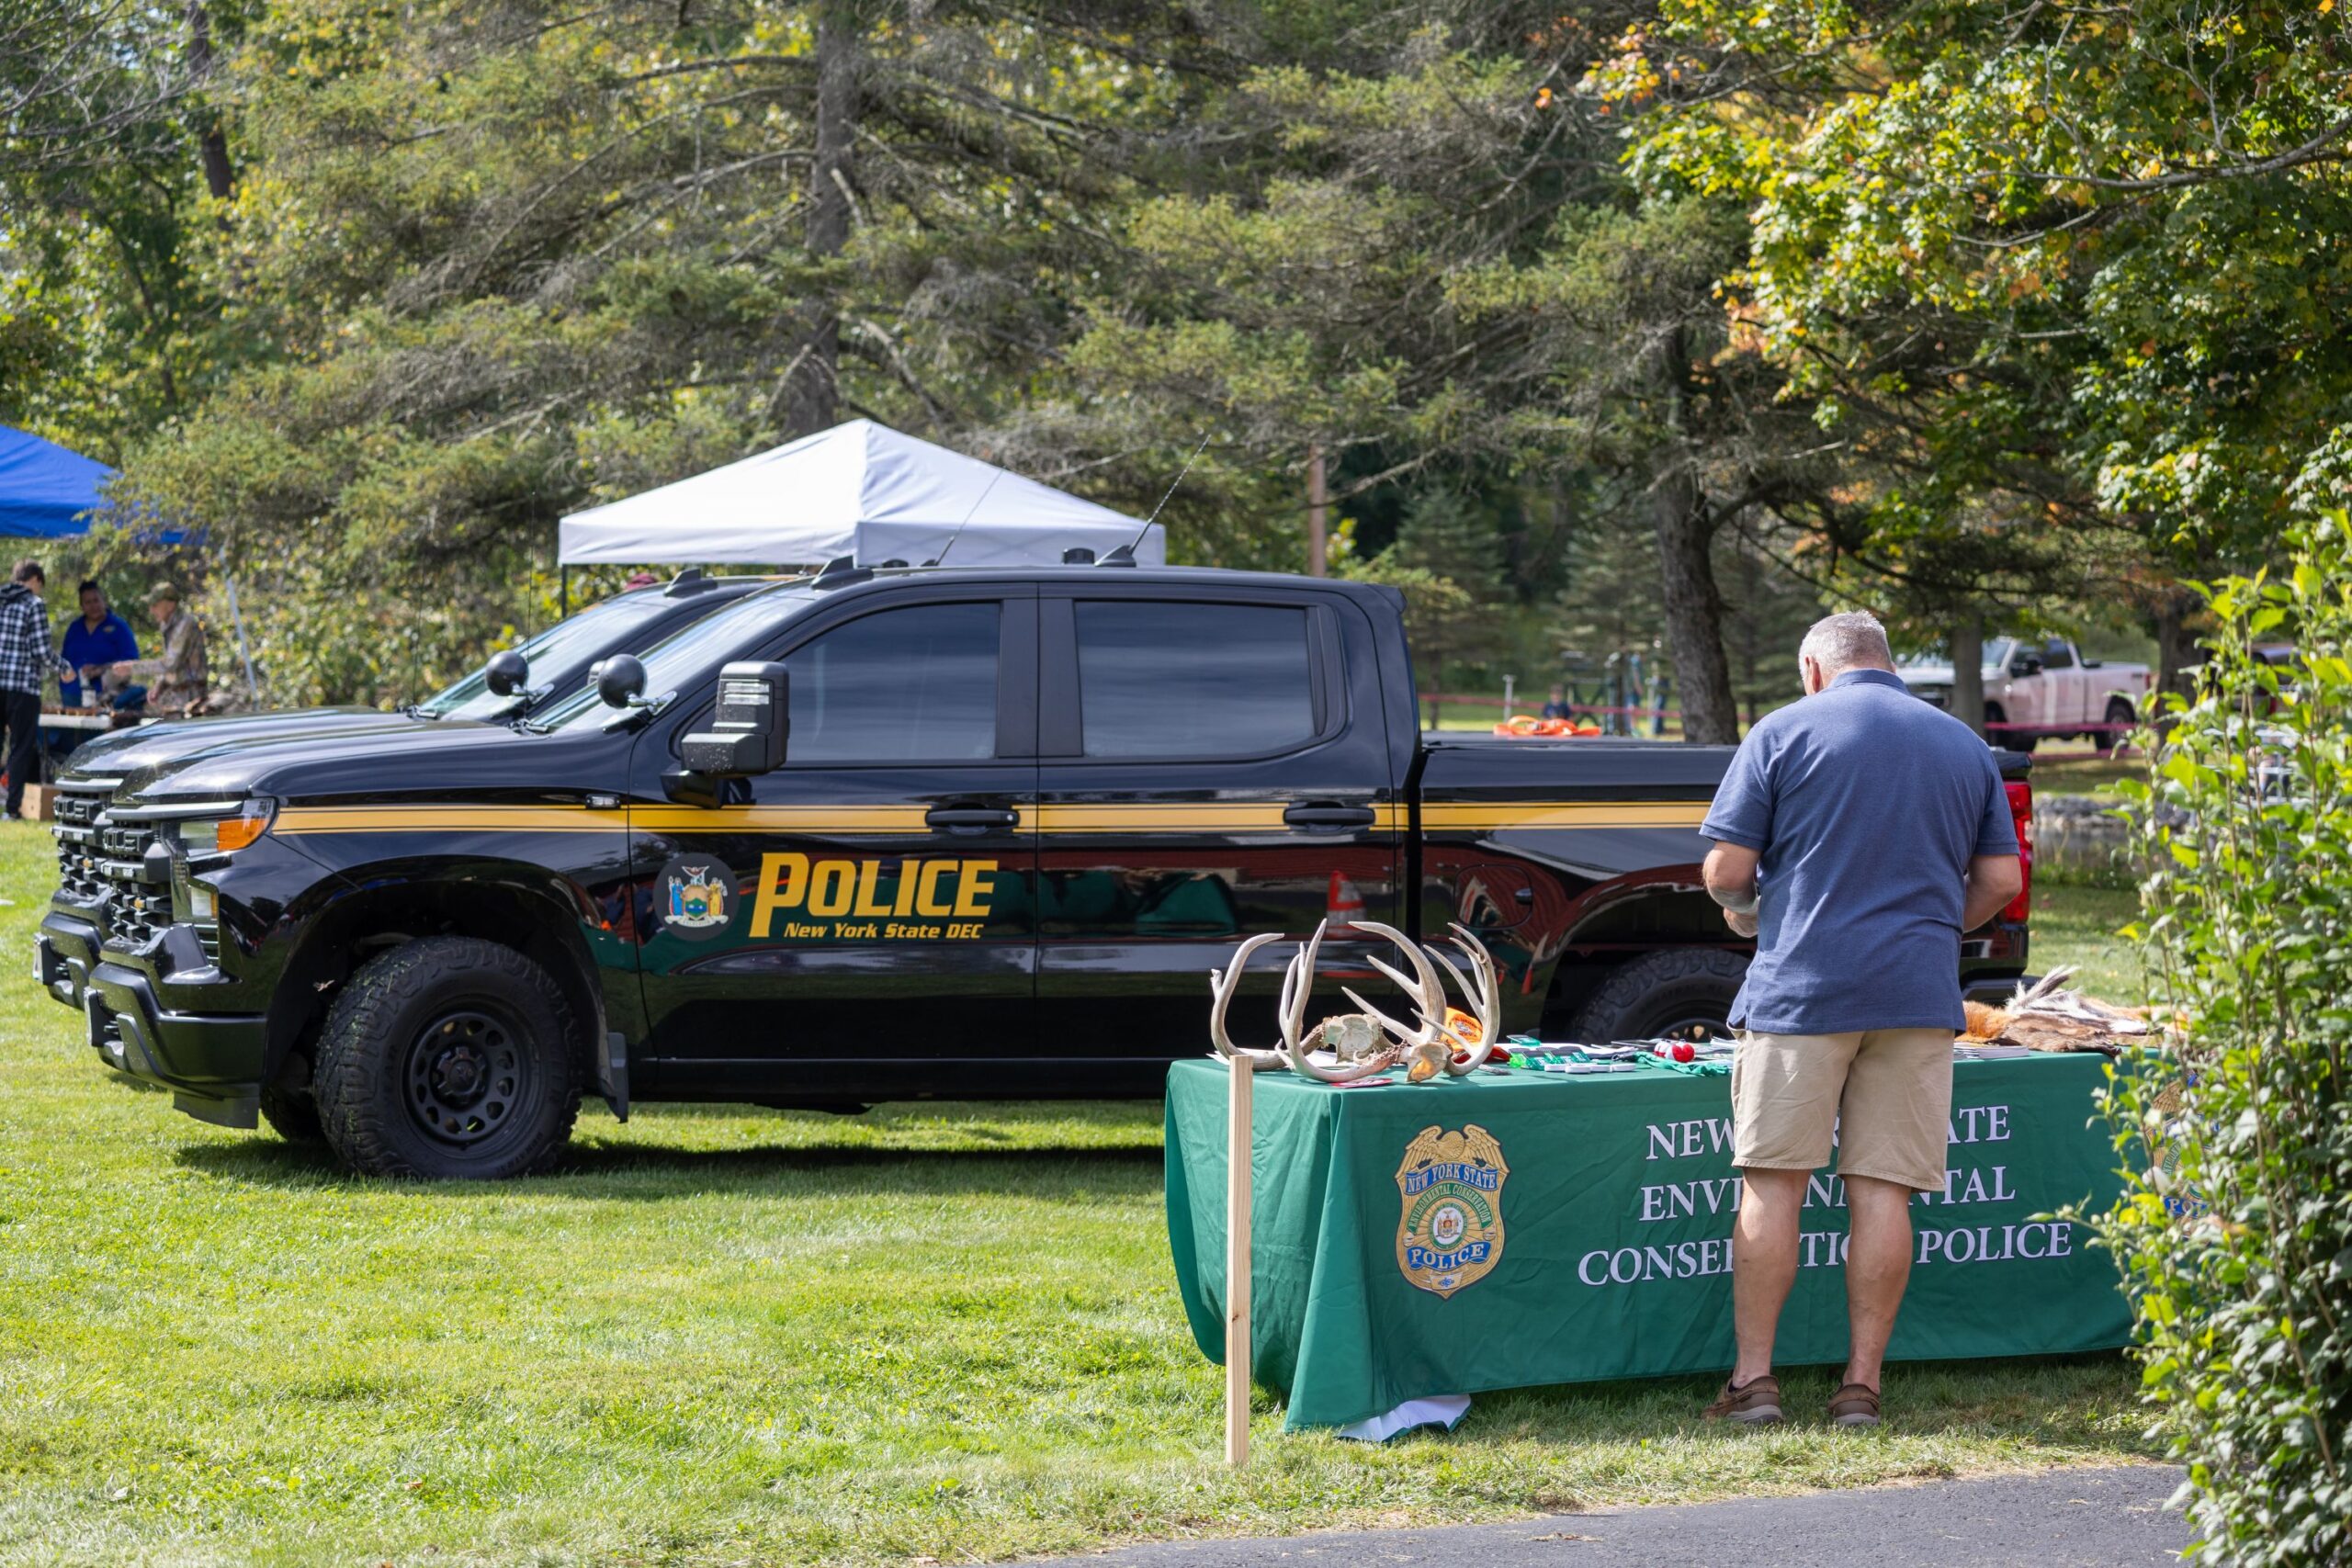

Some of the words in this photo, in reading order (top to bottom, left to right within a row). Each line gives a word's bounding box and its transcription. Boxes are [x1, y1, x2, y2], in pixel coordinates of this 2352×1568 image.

[749, 852, 999, 938] POLICE
[784, 922, 826, 938] New
[834, 922, 877, 938] York
[884, 923, 941, 939] State
[945, 924, 984, 939] DEC
[1646, 1118, 1735, 1159] NEW
[1408, 1173, 1429, 1192] NEW
[1431, 1164, 1460, 1182] YORK
[1464, 1167, 1496, 1189] STATE
[1639, 1166, 2016, 1221] ENVINTAL
[1408, 1183, 1452, 1227] ENVIRONMENTAL
[1453, 1183, 1492, 1224] CONSERVATION
[1411, 1243, 1485, 1269] POLICE
[1578, 1232, 1850, 1286] CONSETI
[1916, 1223, 2072, 1263] POLICE
